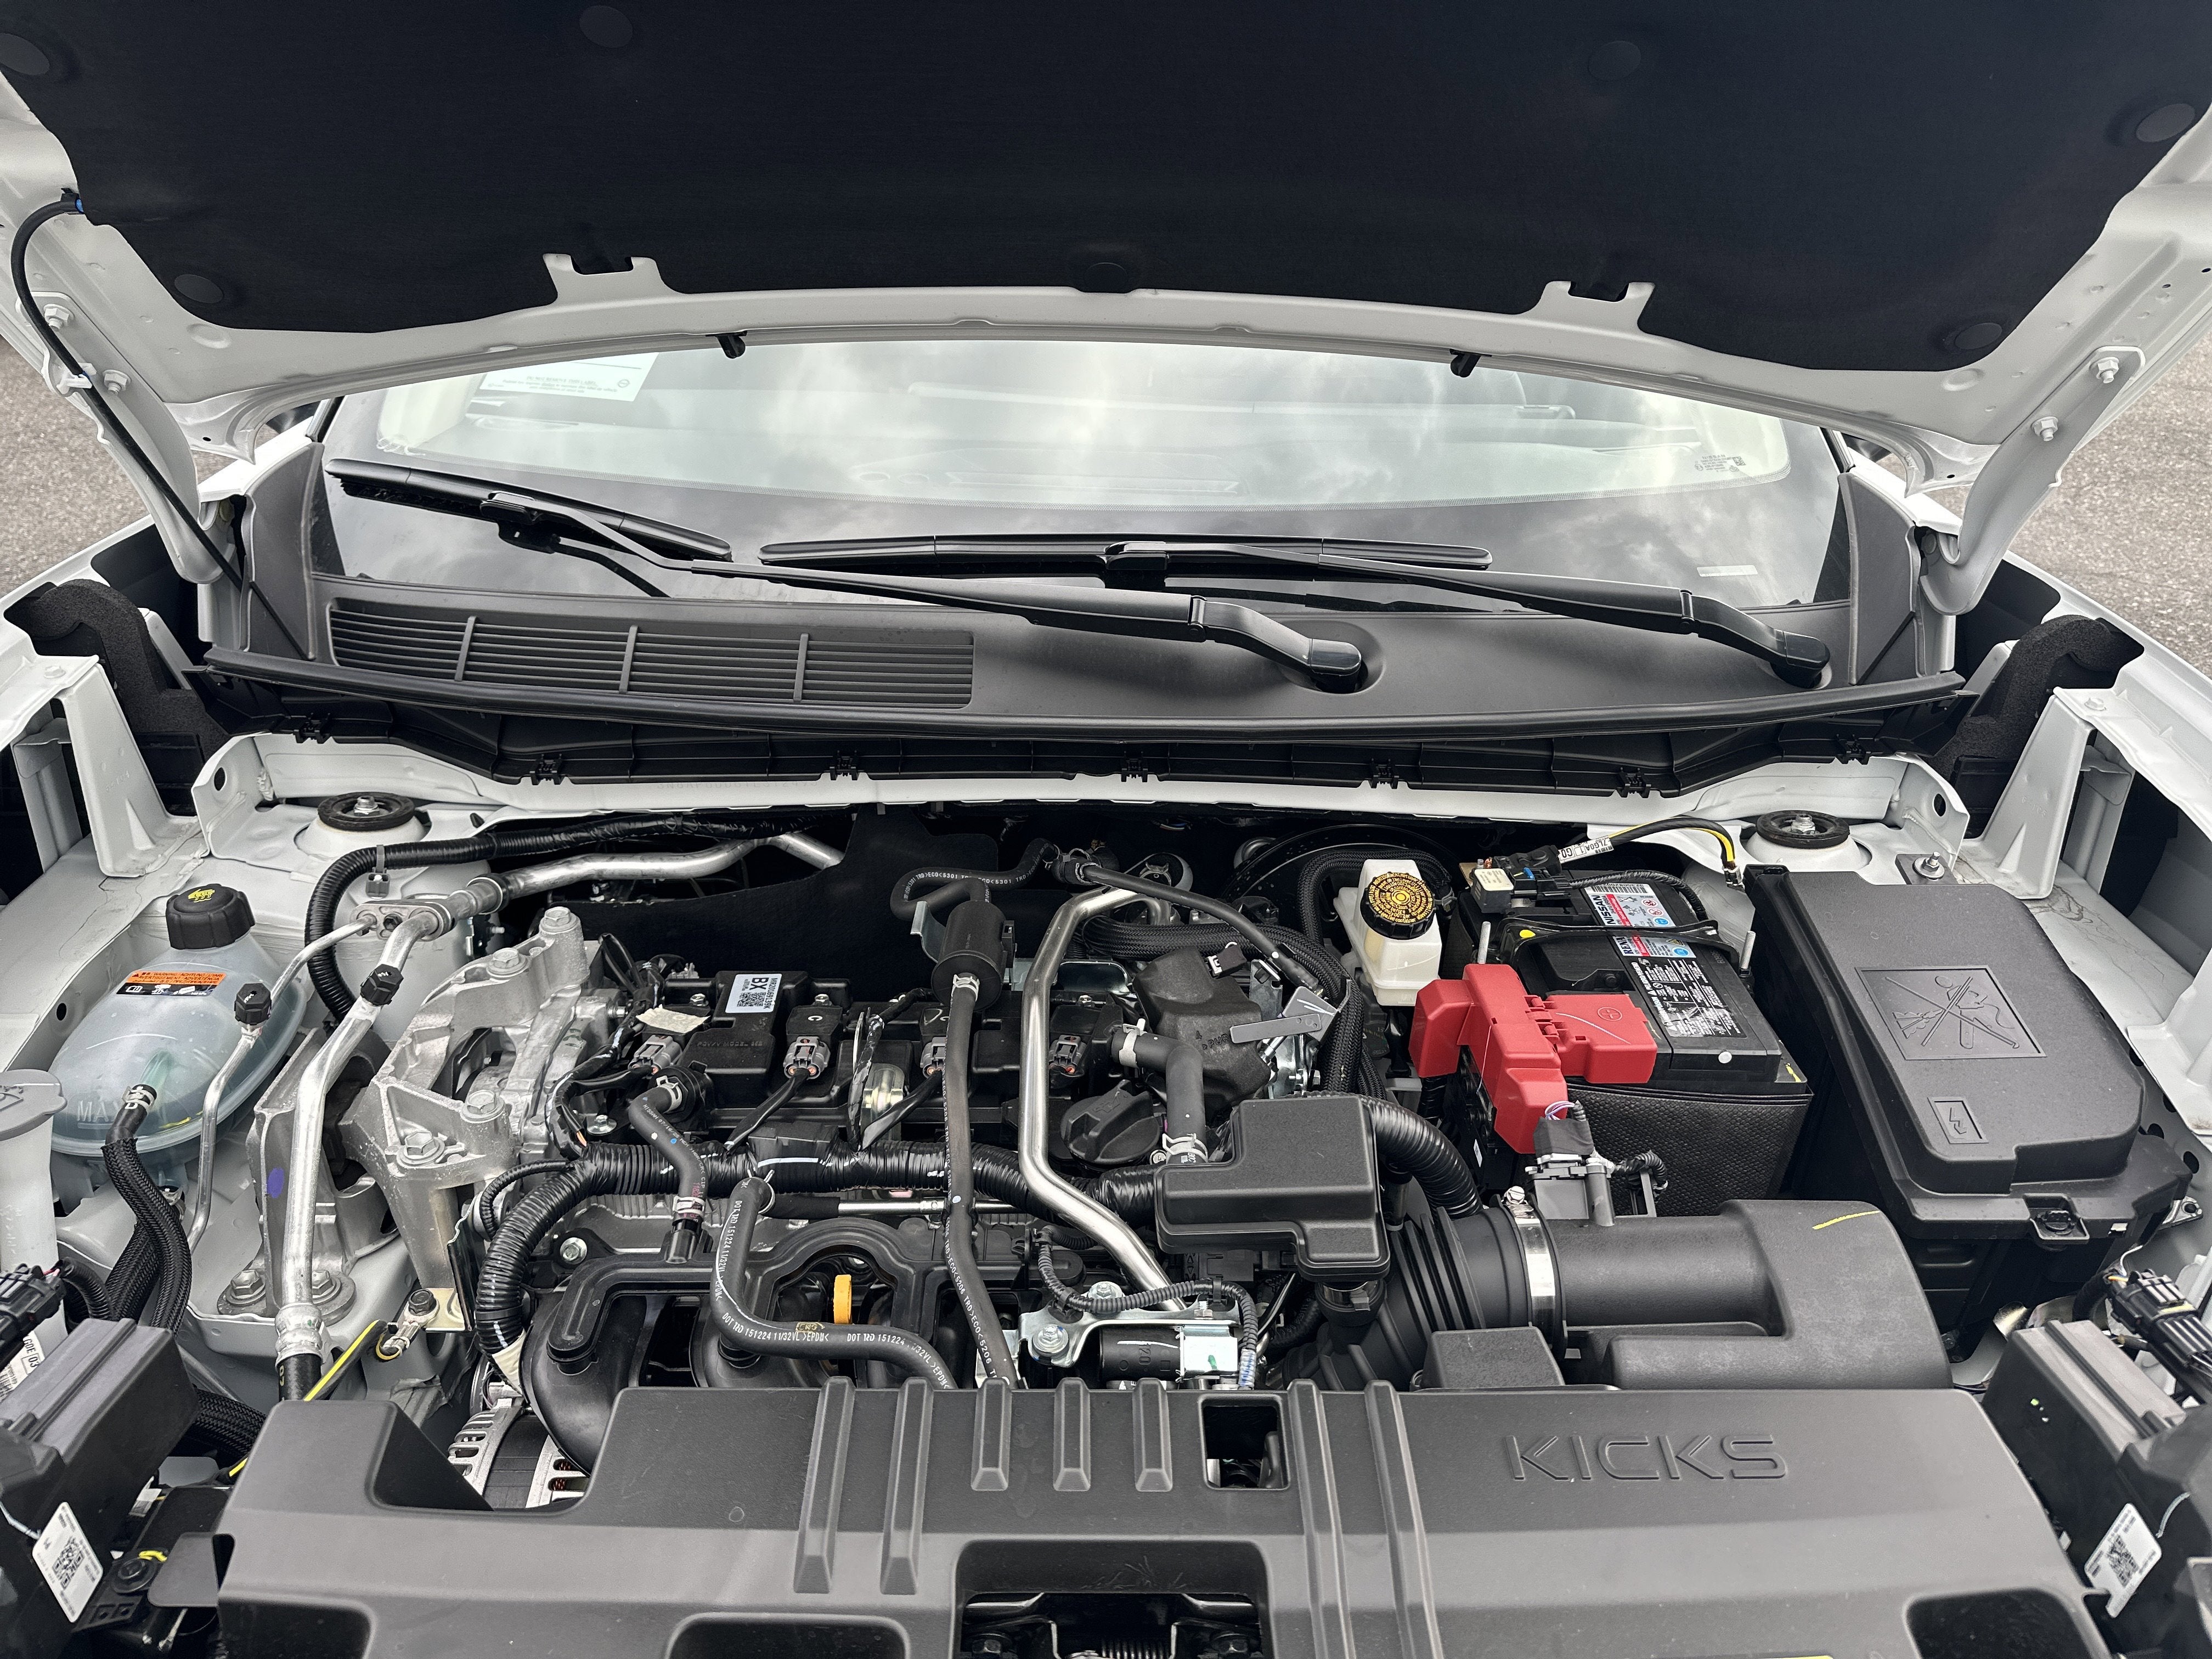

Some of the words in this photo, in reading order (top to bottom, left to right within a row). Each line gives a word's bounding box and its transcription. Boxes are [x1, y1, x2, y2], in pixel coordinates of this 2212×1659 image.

[1591, 895, 1616, 925] NISSAN
[749, 977, 769, 990] BX
[643, 1104, 659, 1120] NISSAN
[735, 1200, 743, 1212] DOT
[724, 1226, 735, 1248] 151224
[722, 1312, 735, 1327] DOT
[744, 1328, 772, 1340] 151224
[774, 1331, 800, 1342] 11/32VL
[847, 1333, 861, 1342] DOT
[877, 1334, 906, 1346] 151224
[1504, 1435, 1787, 1480] KICKS
